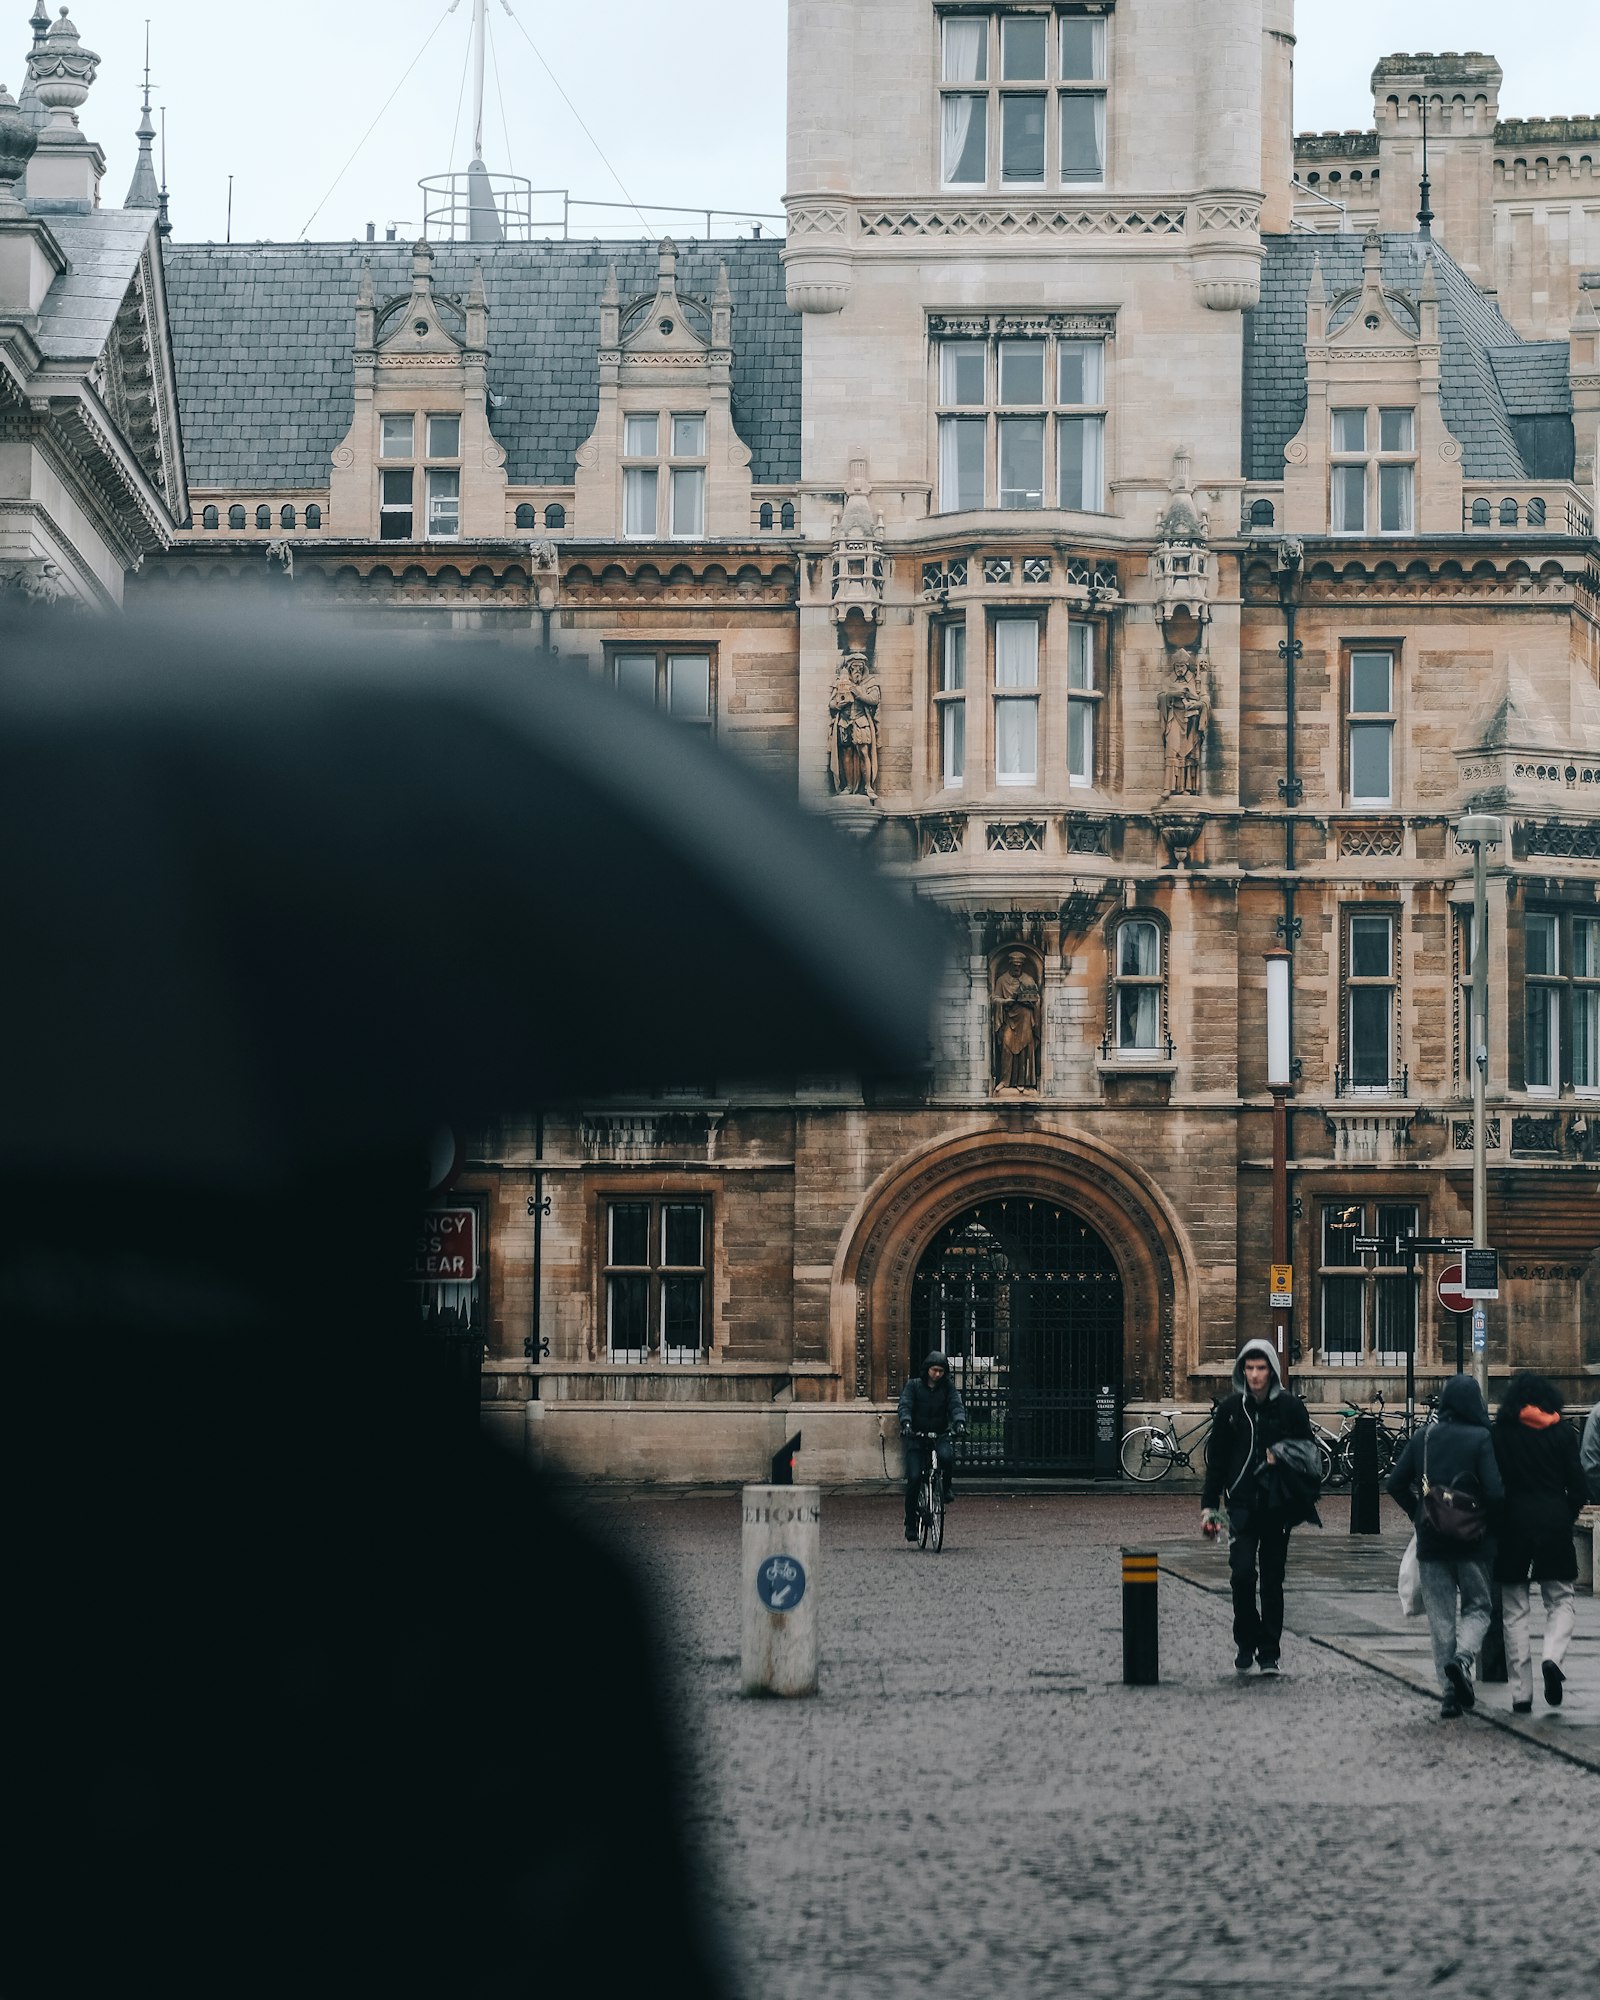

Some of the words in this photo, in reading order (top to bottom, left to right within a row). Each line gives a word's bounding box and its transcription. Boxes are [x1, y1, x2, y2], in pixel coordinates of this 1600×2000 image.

[424, 1216, 467, 1234] NCY
[416, 1236, 442, 1253] SS
[412, 1255, 465, 1273] LEAR
